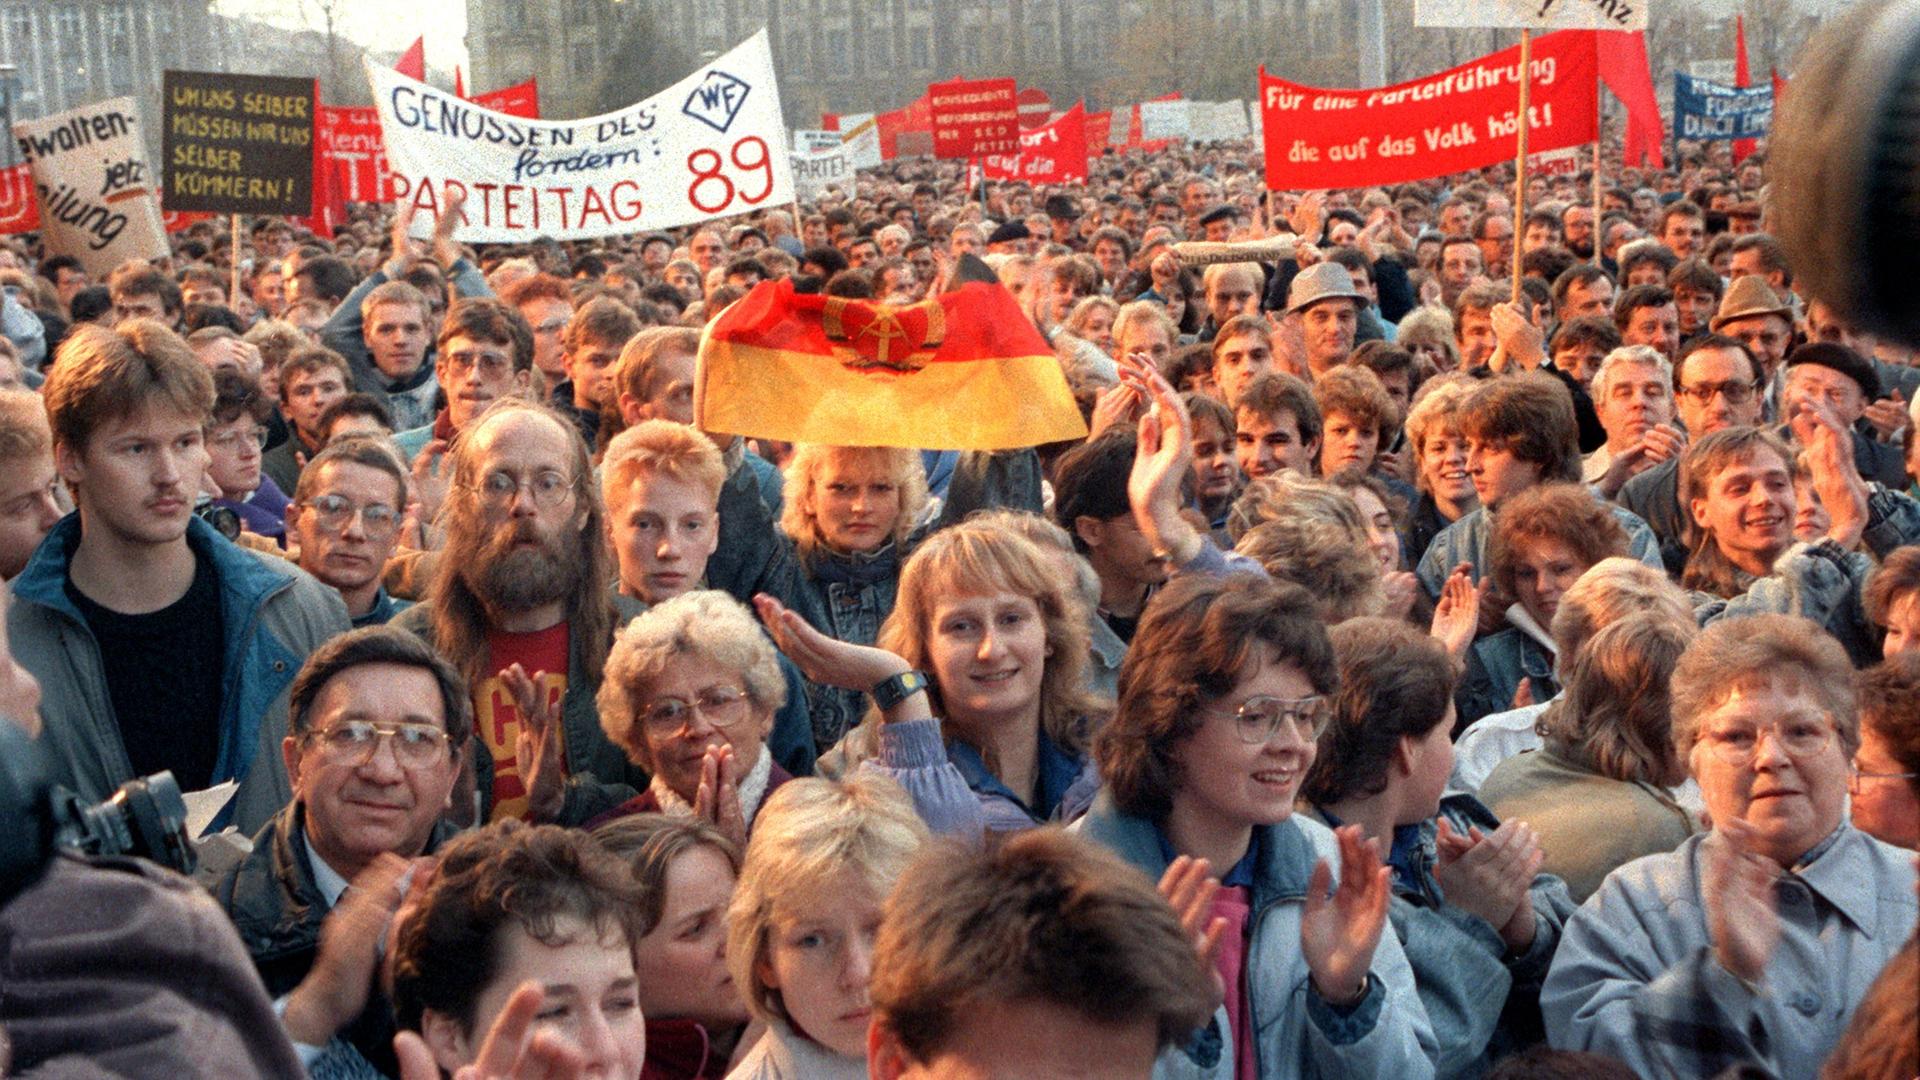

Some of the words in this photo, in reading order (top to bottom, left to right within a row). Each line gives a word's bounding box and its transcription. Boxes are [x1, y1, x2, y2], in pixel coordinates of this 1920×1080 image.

[1266, 86, 1304, 110] Für
[173, 113, 242, 139] MÜSSEN
[598, 104, 657, 142] DES
[1288, 139, 1320, 163] die
[1328, 137, 1370, 161] auf
[1377, 135, 1416, 156] das
[1425, 121, 1476, 151] Volk
[1489, 102, 1552, 139] höt!
[173, 144, 242, 171] SELBER
[687, 136, 774, 214] 89
